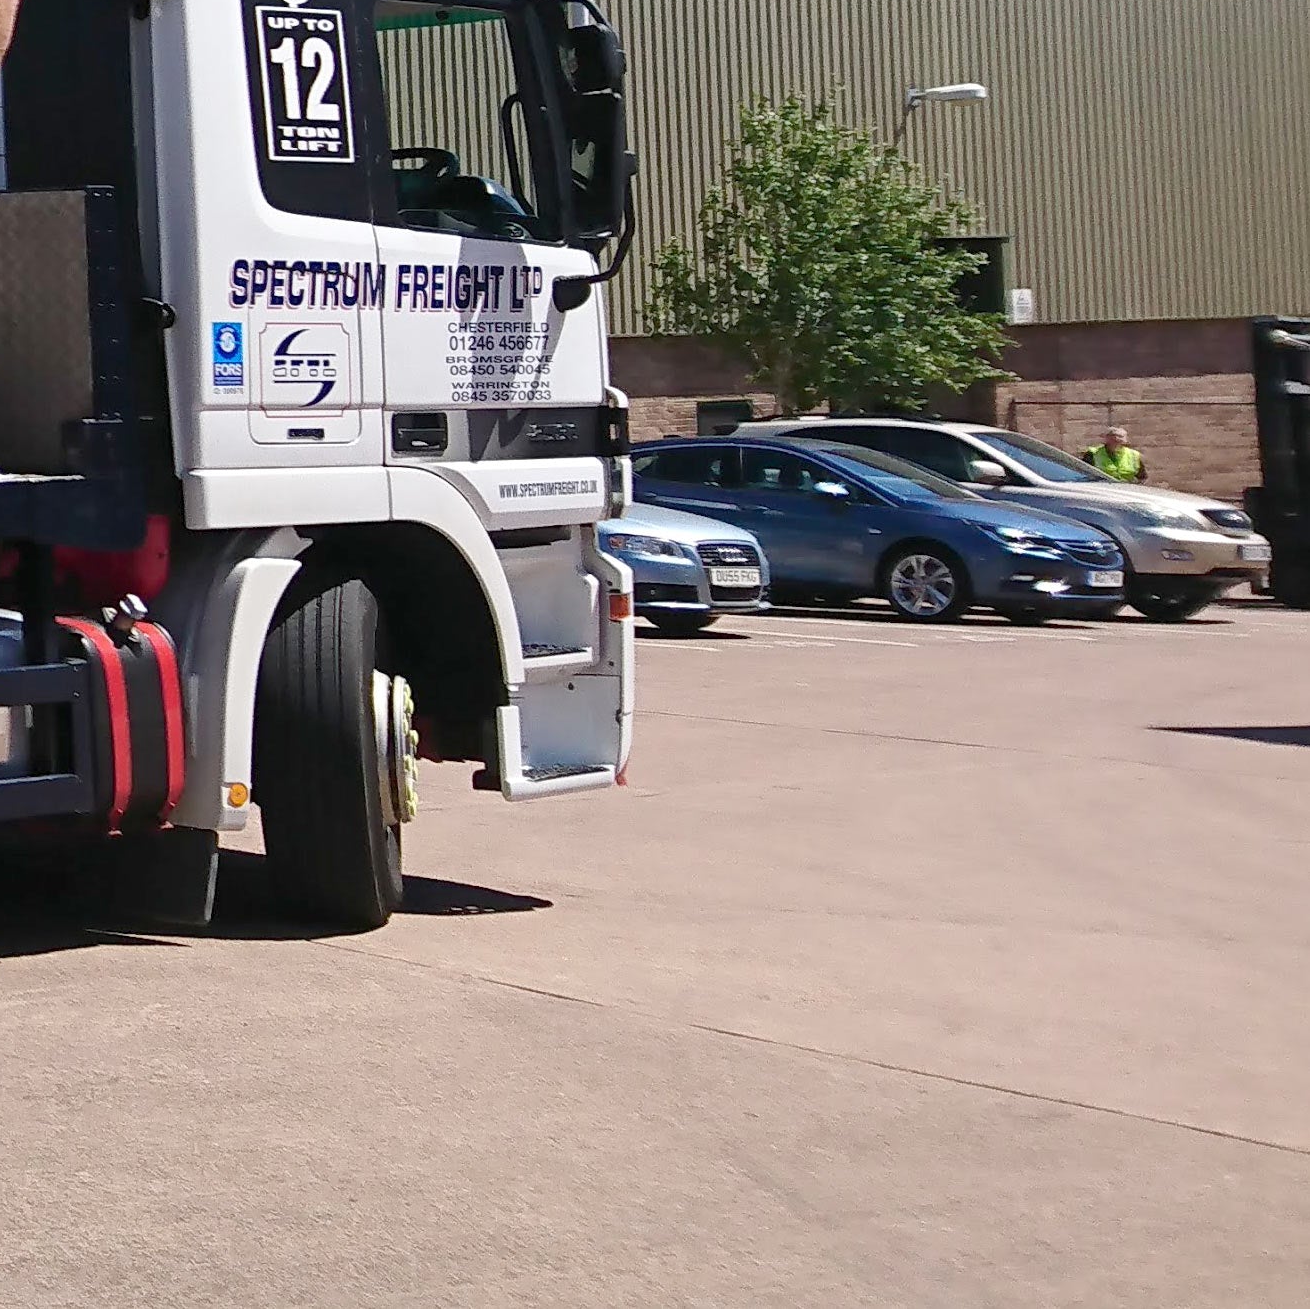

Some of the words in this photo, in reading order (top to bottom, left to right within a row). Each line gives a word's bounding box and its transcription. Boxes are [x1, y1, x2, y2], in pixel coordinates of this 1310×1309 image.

[267, 16, 300, 30] UP
[302, 18, 335, 32] TO
[270, 36, 341, 121] 12
[277, 125, 340, 139] TON
[280, 139, 343, 153] LIFT
[230, 259, 386, 310] SPECTRUM
[395, 264, 504, 313] FREIGHT
[508, 265, 543, 313] LTD
[447, 322, 550, 333] CHESTERFIELD
[449, 335, 495, 351] 01246
[499, 335, 549, 351] 456677
[445, 355, 553, 364] BROMSGROVE
[214, 363, 242, 377] FORS
[450, 364, 495, 376] 08450
[499, 364, 551, 375] 540045
[451, 380, 550, 390] WARRINGTON
[451, 391, 488, 402] 0845
[491, 390, 552, 402] 3570033
[498, 479, 598, 499] WWW.SPECTRUMFREIGHT.CO.UK
